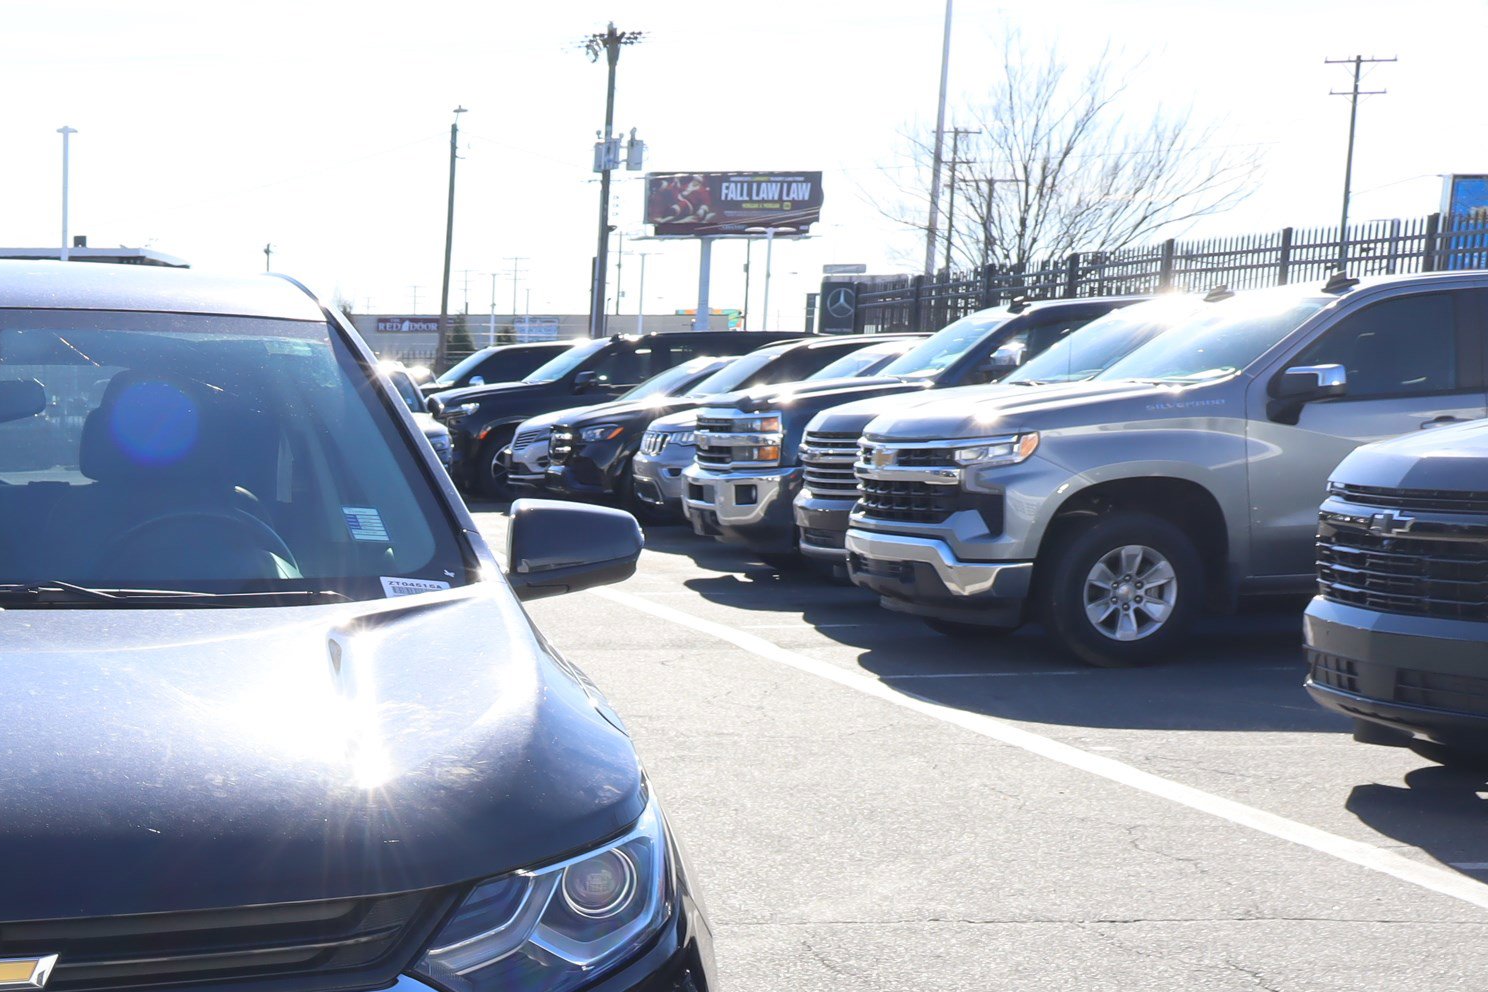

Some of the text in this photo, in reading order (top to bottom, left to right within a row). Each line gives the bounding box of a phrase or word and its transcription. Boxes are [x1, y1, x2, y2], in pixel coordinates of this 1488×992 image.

[721, 182, 811, 201] FALL LAW LAW
[378, 323, 438, 331] RED DOOR
